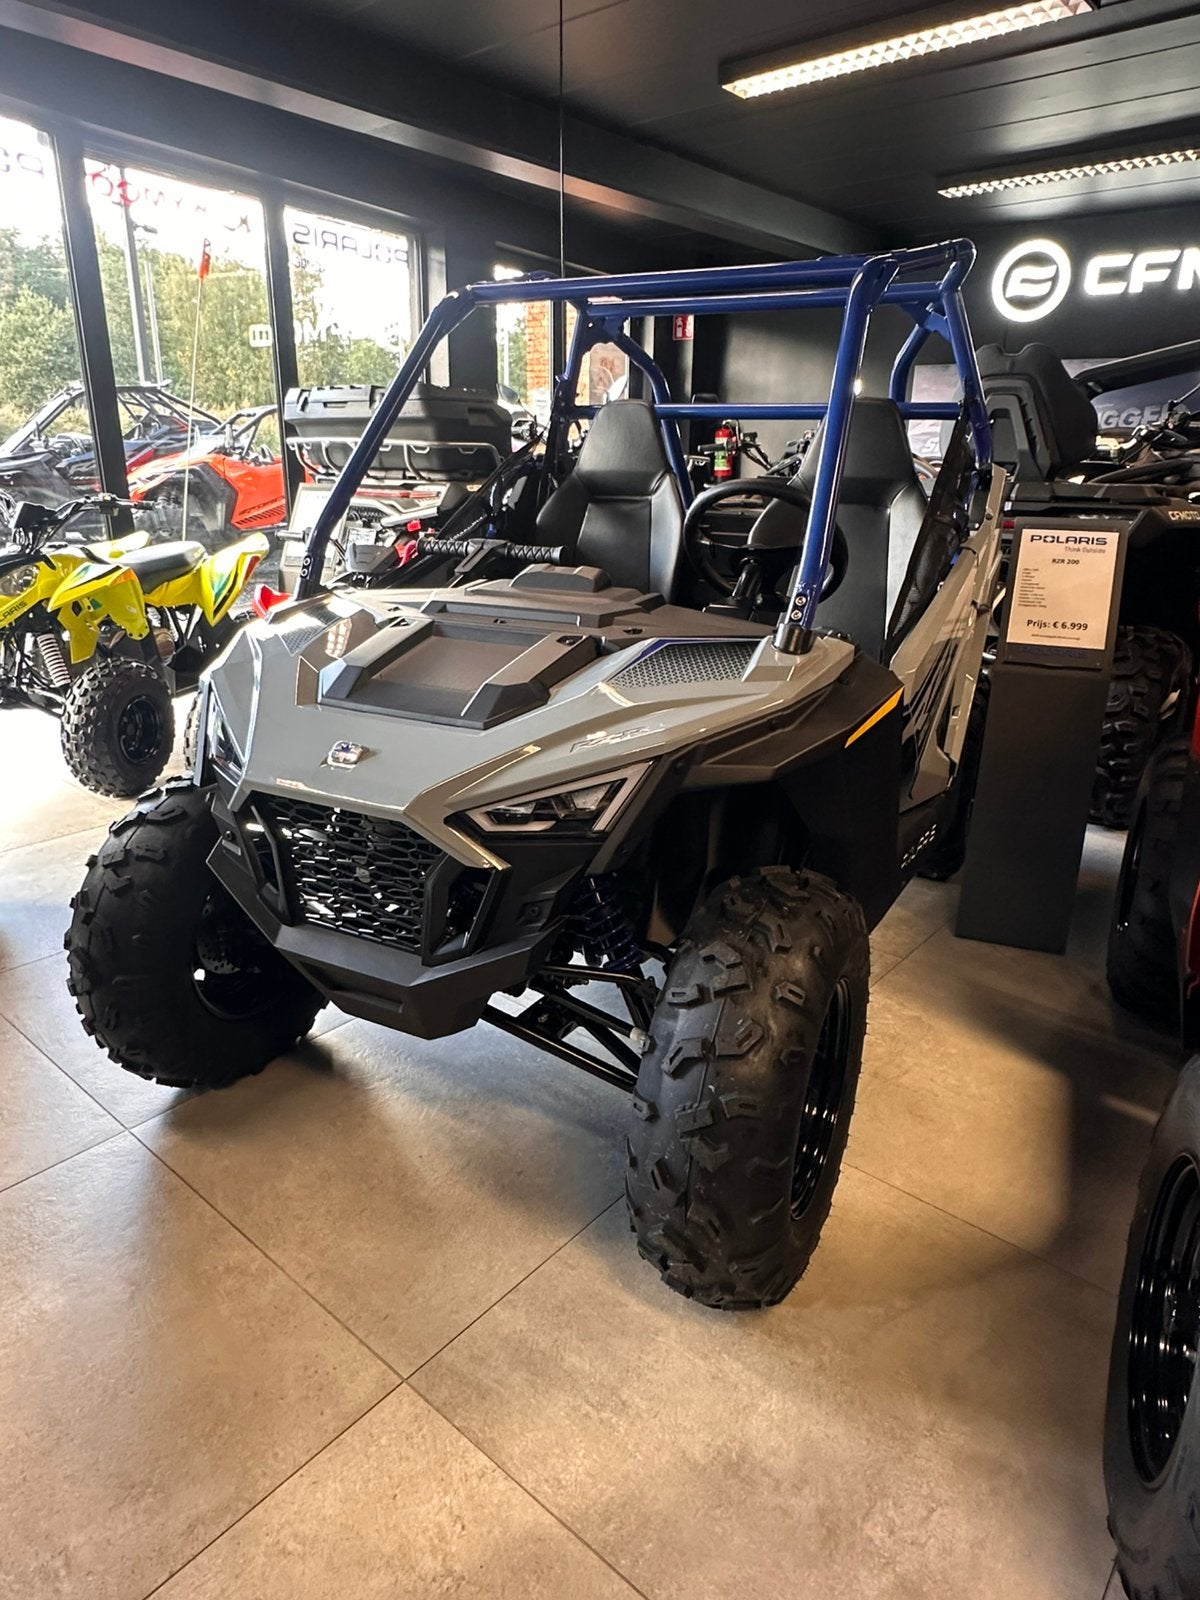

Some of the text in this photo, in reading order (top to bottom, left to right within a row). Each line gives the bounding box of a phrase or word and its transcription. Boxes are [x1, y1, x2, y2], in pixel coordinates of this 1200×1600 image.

[1030, 534, 1108, 546] POLARIS
[1026, 619, 1089, 631] Prijs: € 6.999
